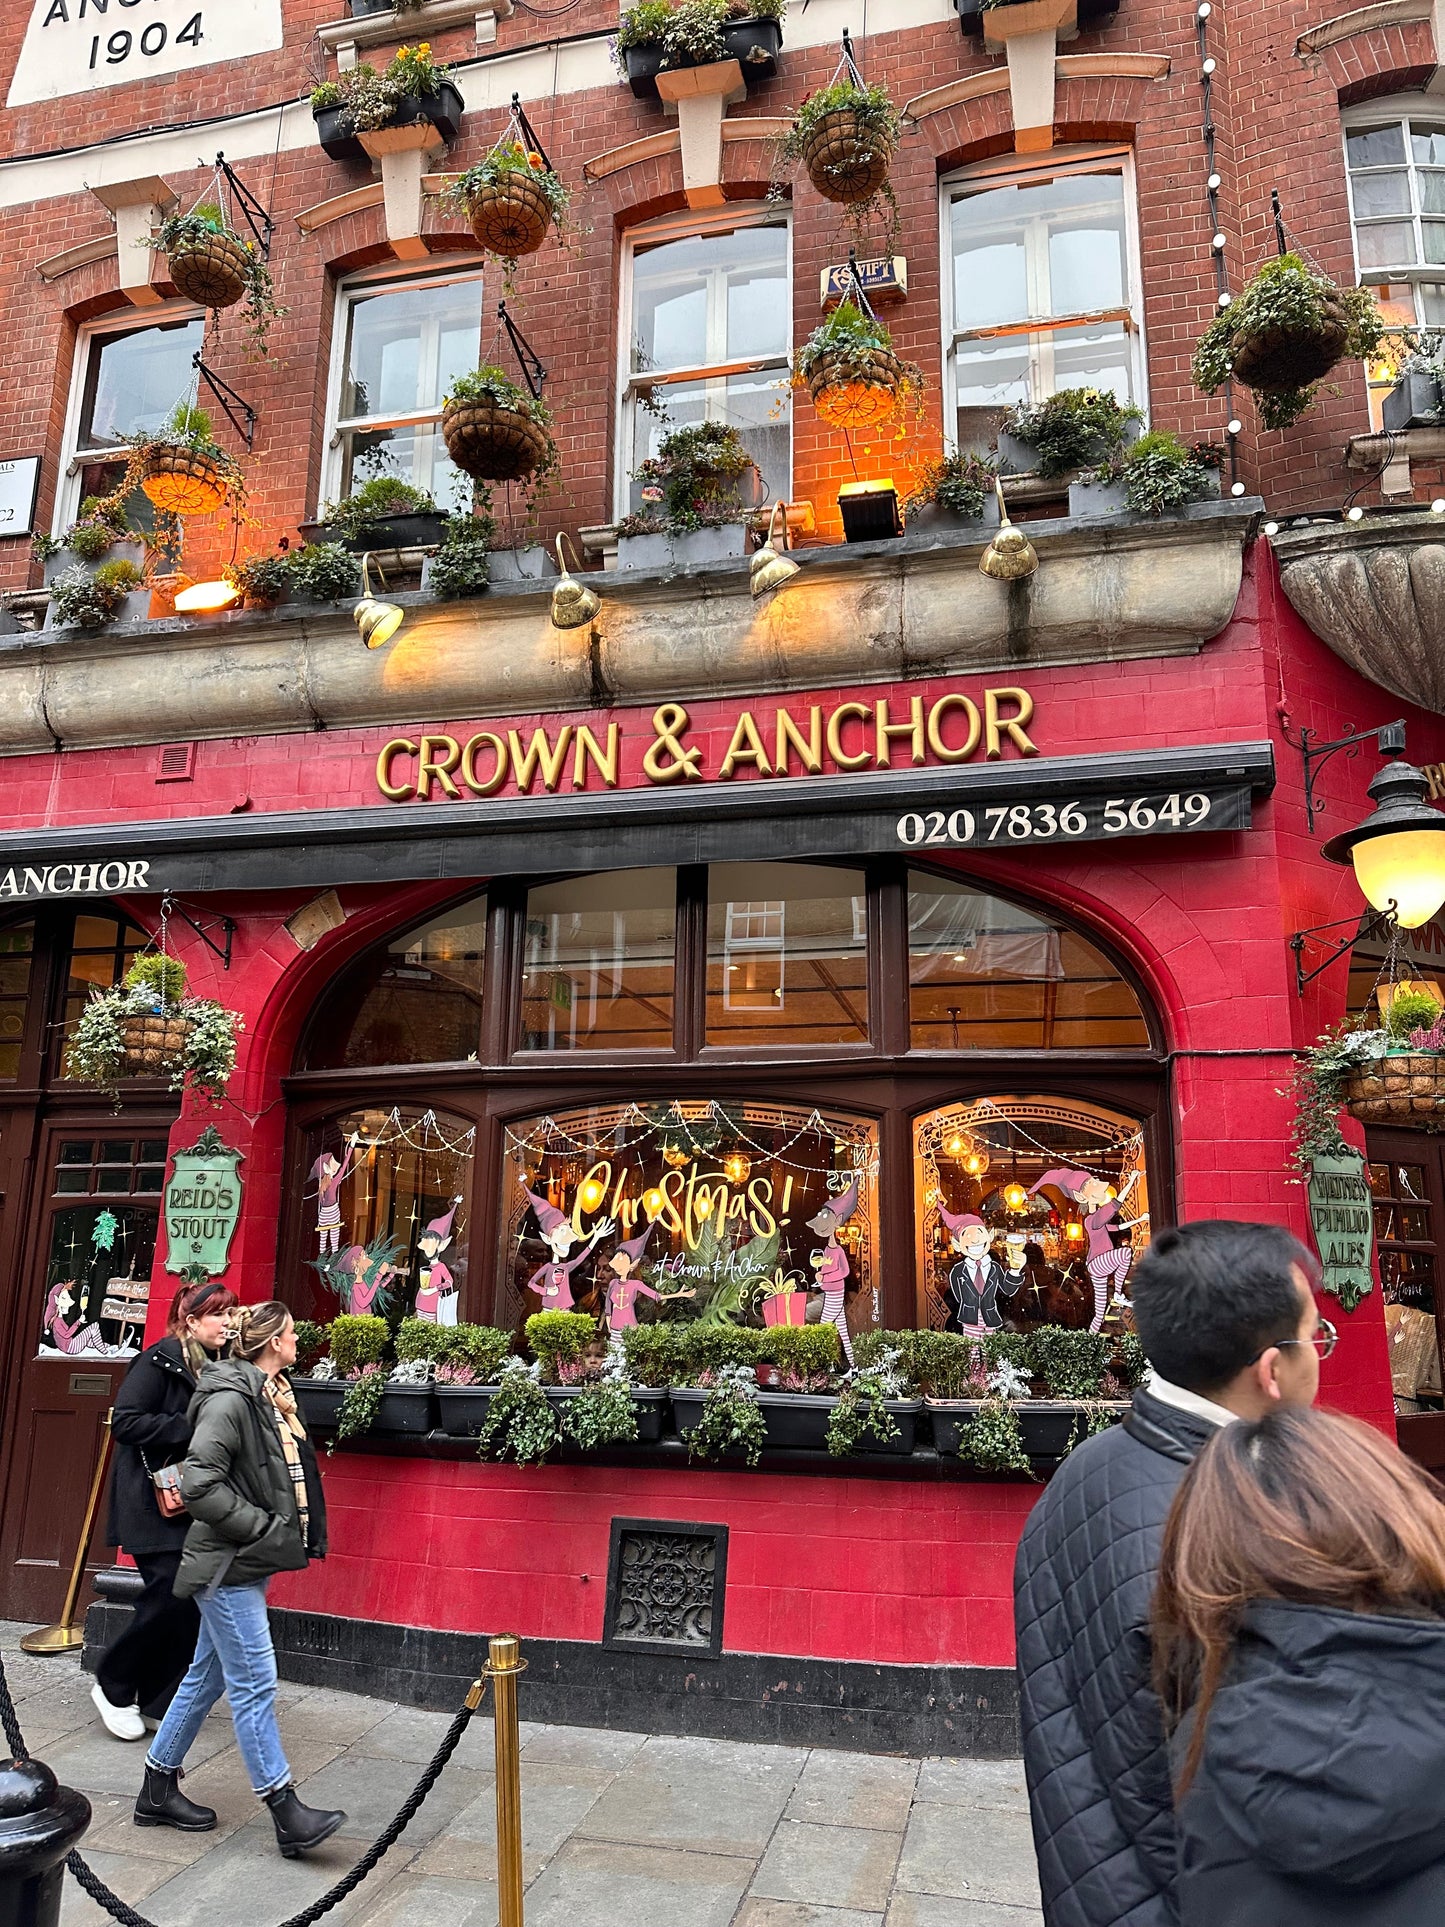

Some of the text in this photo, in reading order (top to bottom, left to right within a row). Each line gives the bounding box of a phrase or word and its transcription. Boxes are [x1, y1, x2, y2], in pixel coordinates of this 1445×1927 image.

[89, 12, 204, 69] 1904
[376, 686, 1041, 800] CROWN & ANCHOR
[896, 793, 1211, 845] 020 7836 5649
[0, 860, 150, 897] ANCHOR
[169, 1182, 233, 1210] REID'S
[170, 1218, 231, 1239] STOUT
[652, 1251, 672, 1286] at
[671, 1251, 710, 1279] Crown
[1325, 1241, 1366, 1266] ALES
